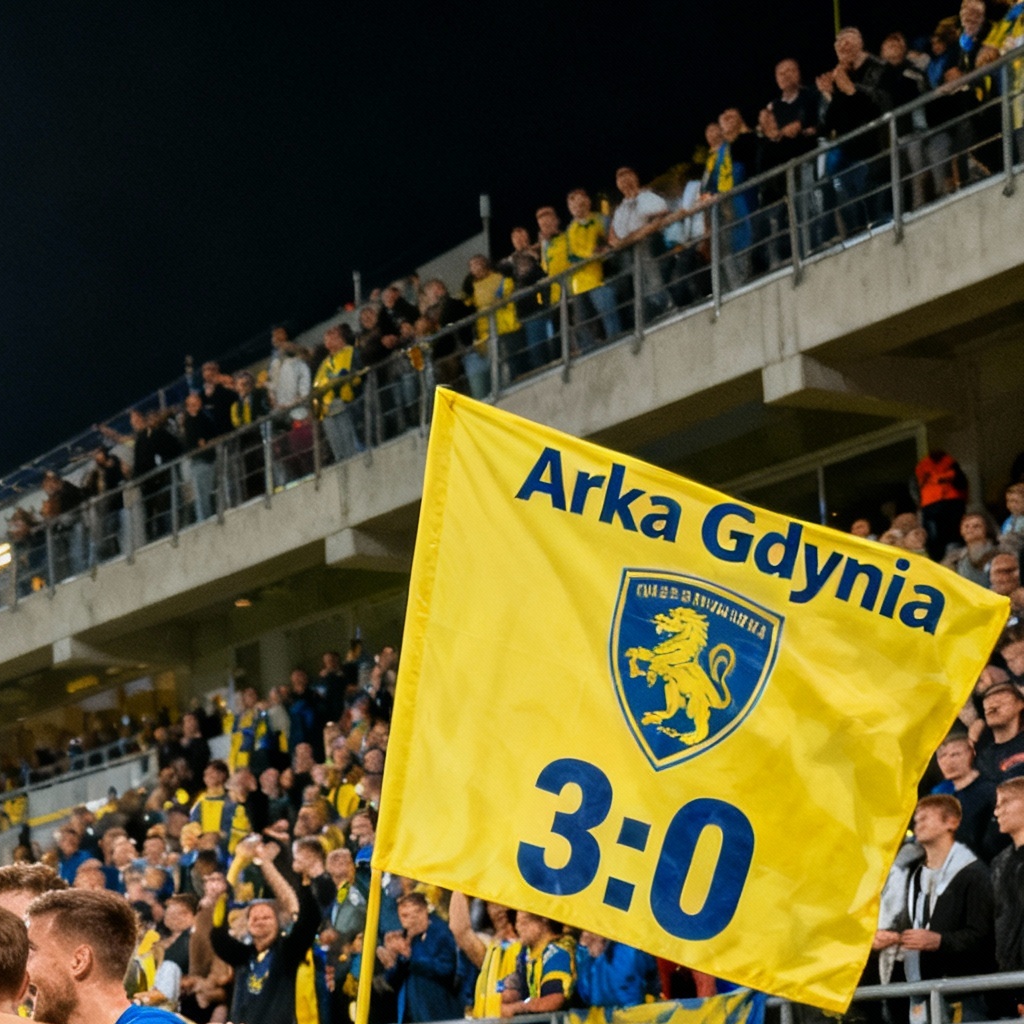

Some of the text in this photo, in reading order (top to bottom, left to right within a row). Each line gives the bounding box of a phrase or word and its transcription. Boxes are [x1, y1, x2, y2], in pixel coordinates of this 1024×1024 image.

[515, 448, 683, 543] Arka
[702, 502, 945, 635] Gdynia
[517, 758, 755, 941] 3:0
